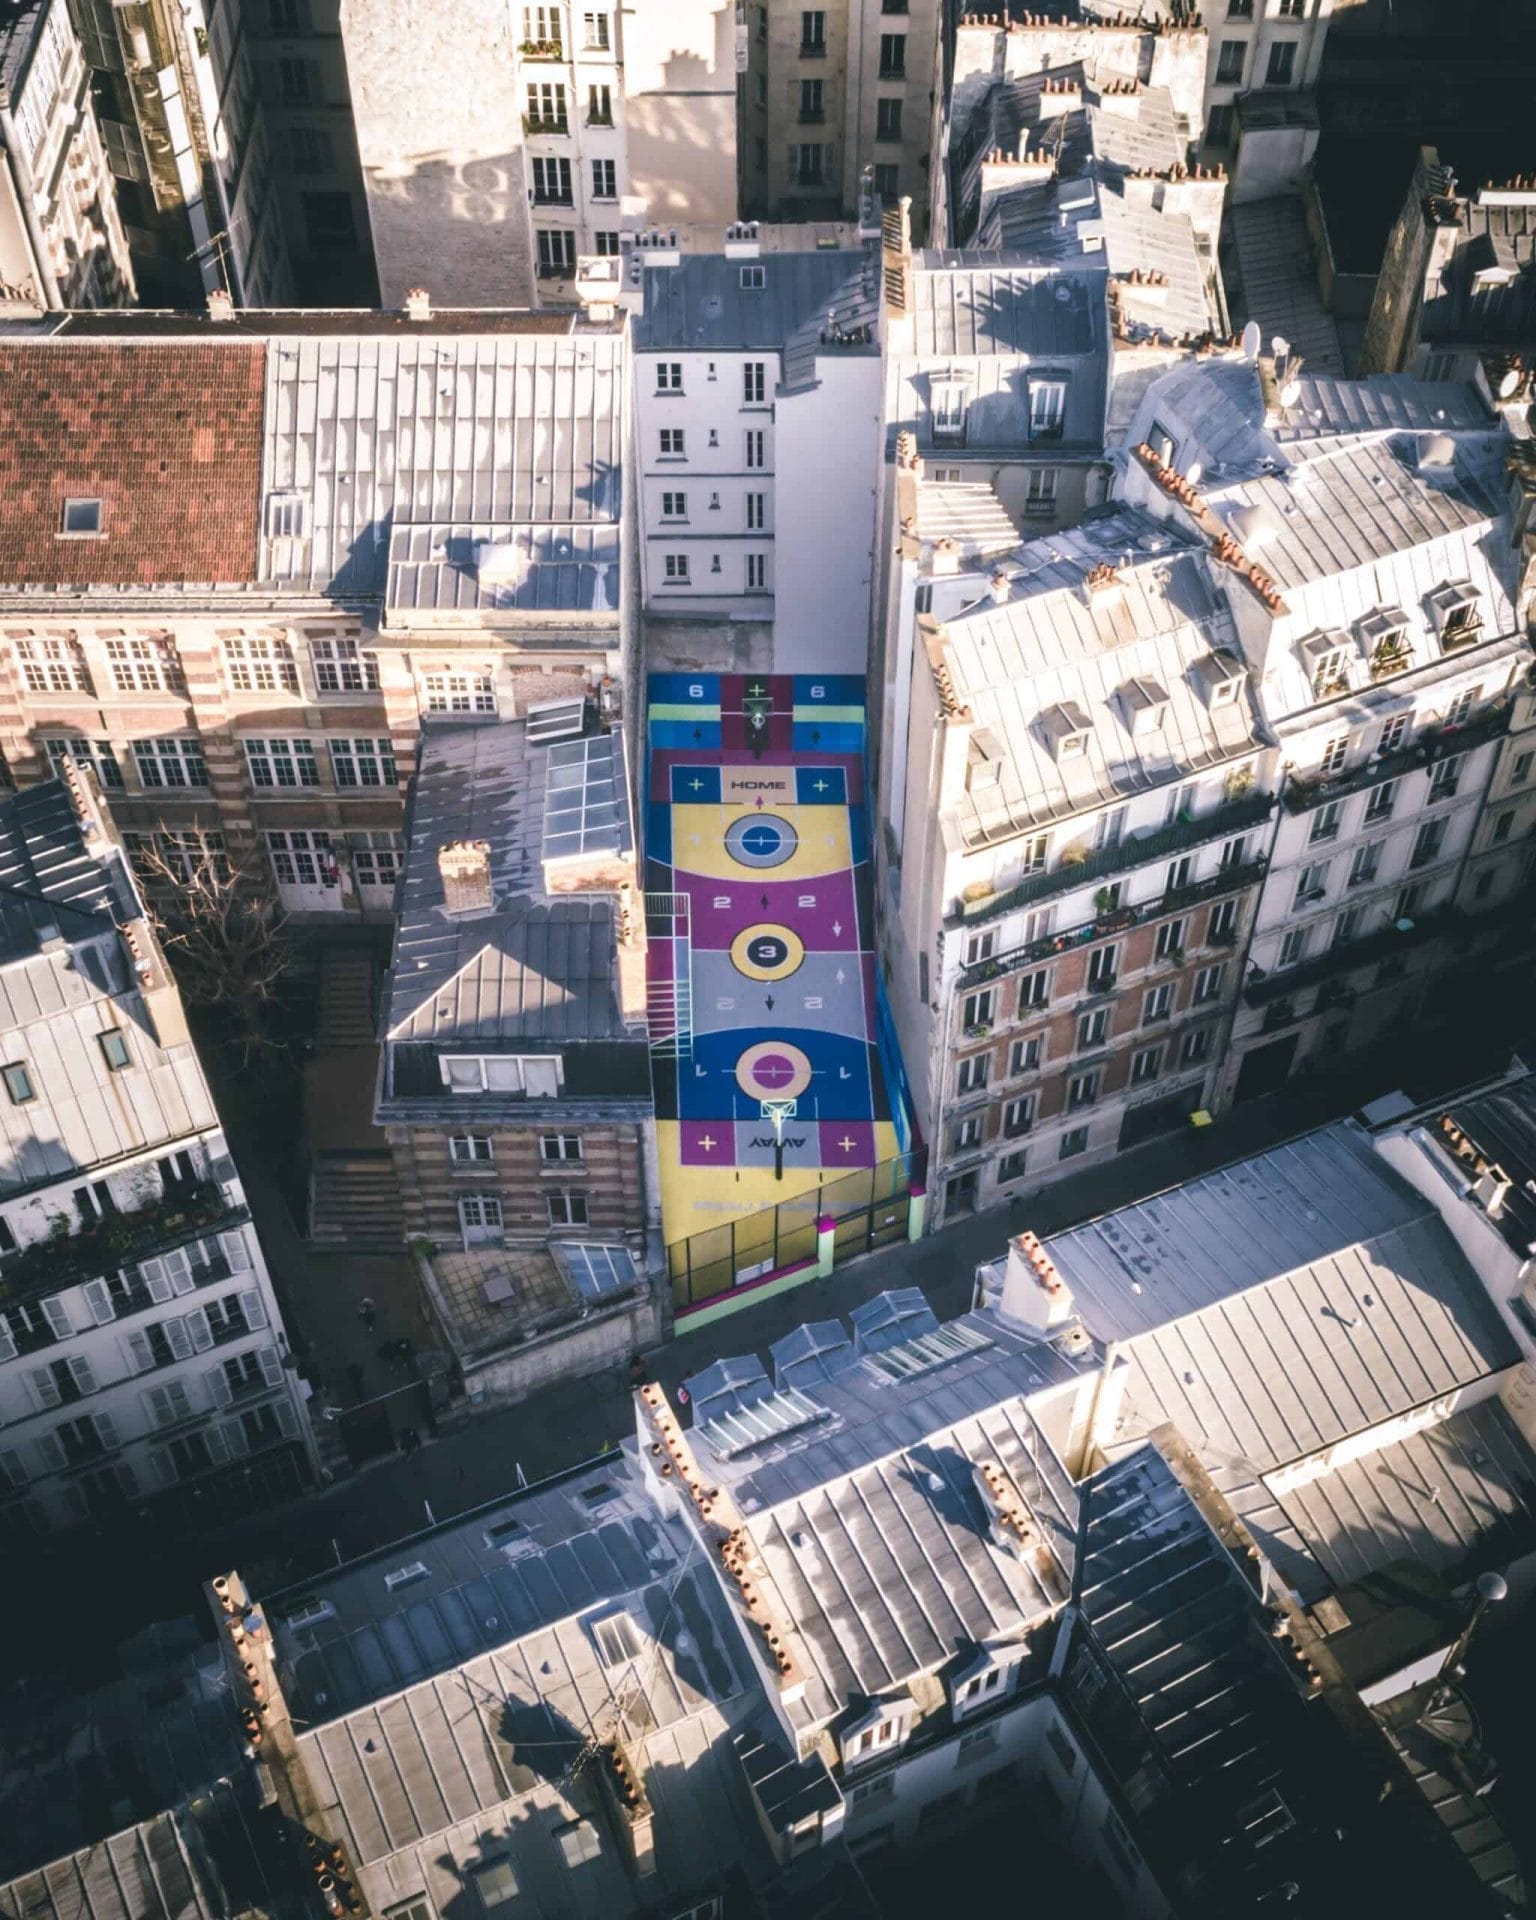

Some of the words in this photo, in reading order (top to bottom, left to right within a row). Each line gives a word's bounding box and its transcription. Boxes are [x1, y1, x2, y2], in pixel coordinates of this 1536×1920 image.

[689, 685, 704, 698] 6
[811, 686, 825, 698] 6
[731, 780, 786, 790] HOME
[713, 896, 731, 909] 2
[798, 895, 816, 908] 2
[758, 945, 776, 959] 3
